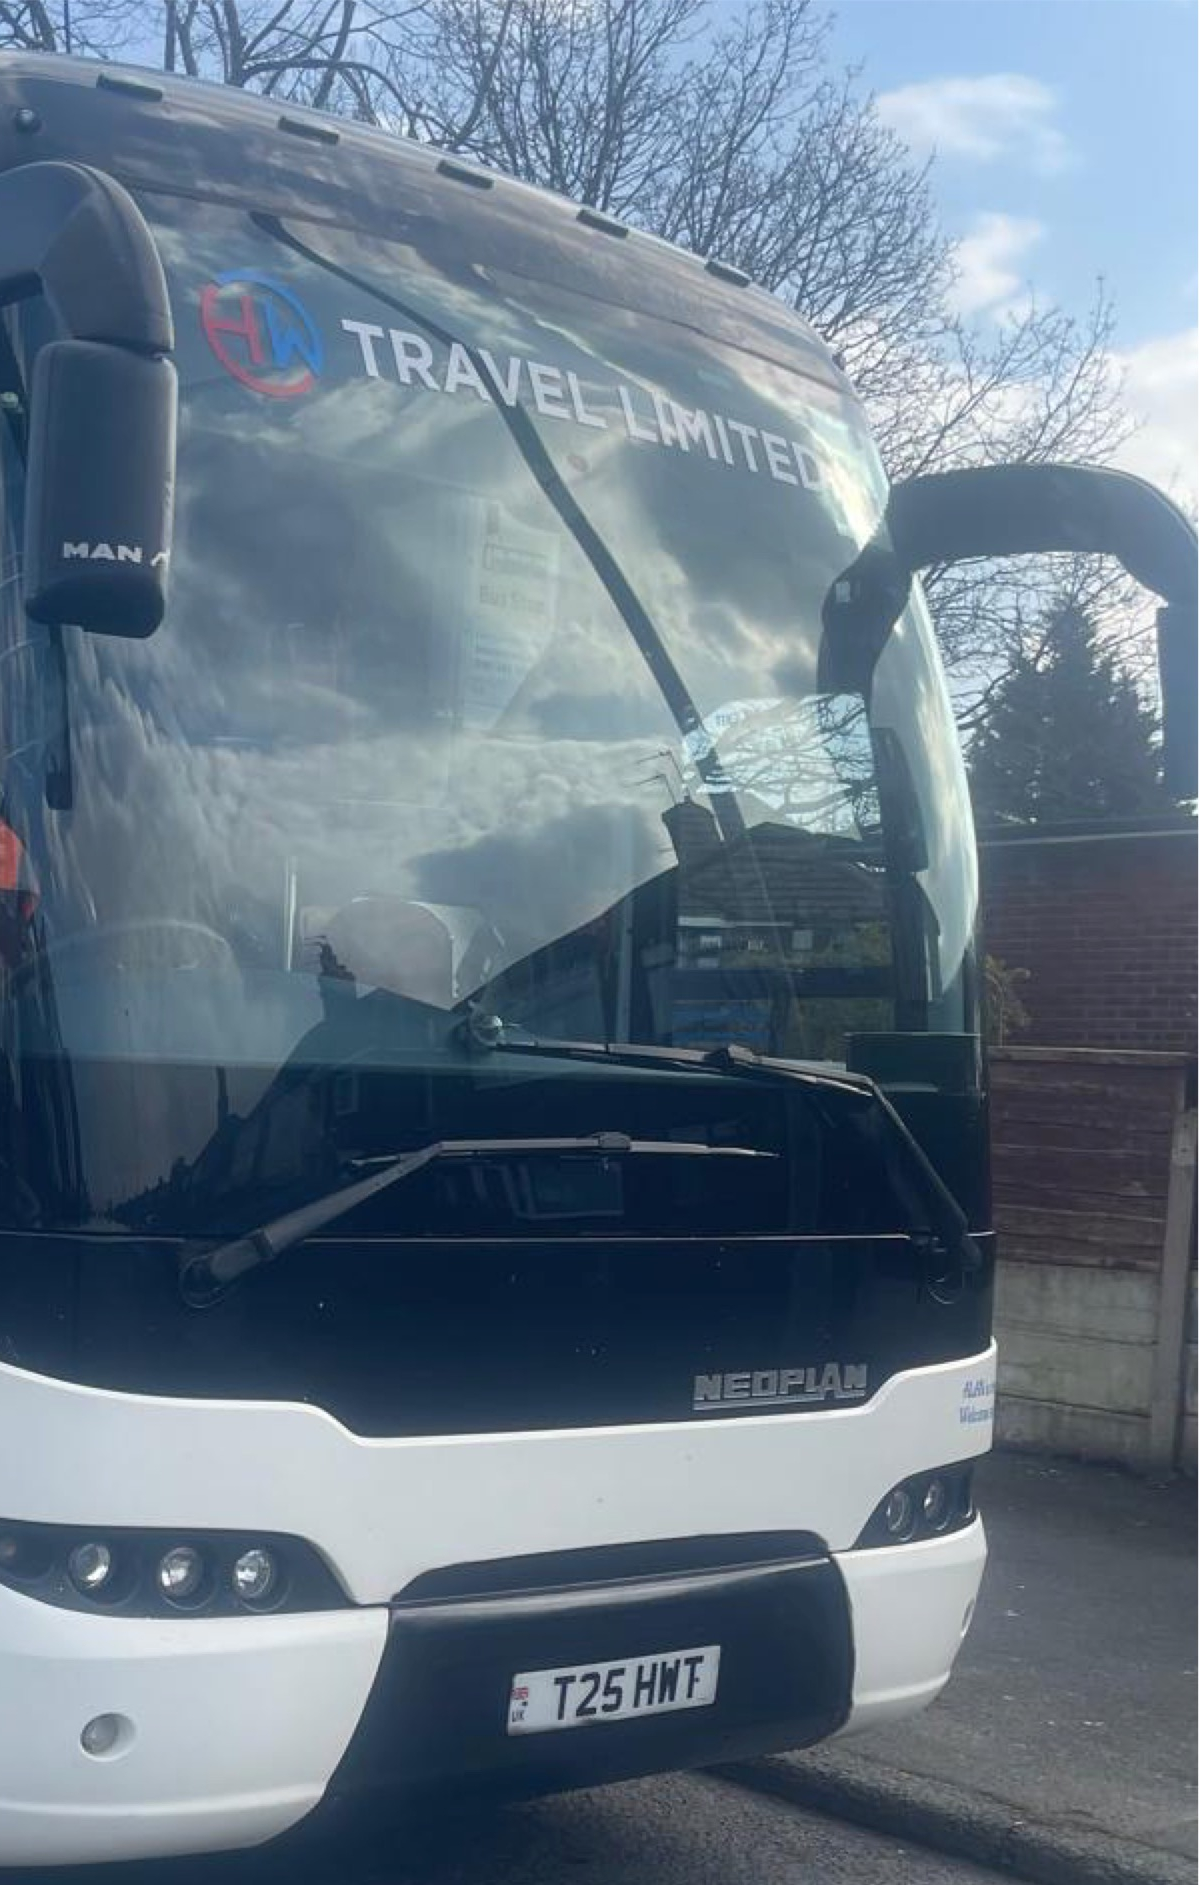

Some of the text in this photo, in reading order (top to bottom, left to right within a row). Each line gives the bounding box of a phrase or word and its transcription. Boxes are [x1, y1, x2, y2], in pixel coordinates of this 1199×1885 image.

[342, 319, 828, 492] TRAVEL LIMITED
[63, 541, 143, 563] MAN
[693, 1362, 868, 1402] NEOPLAN
[554, 1655, 705, 1721] T25 HWT
